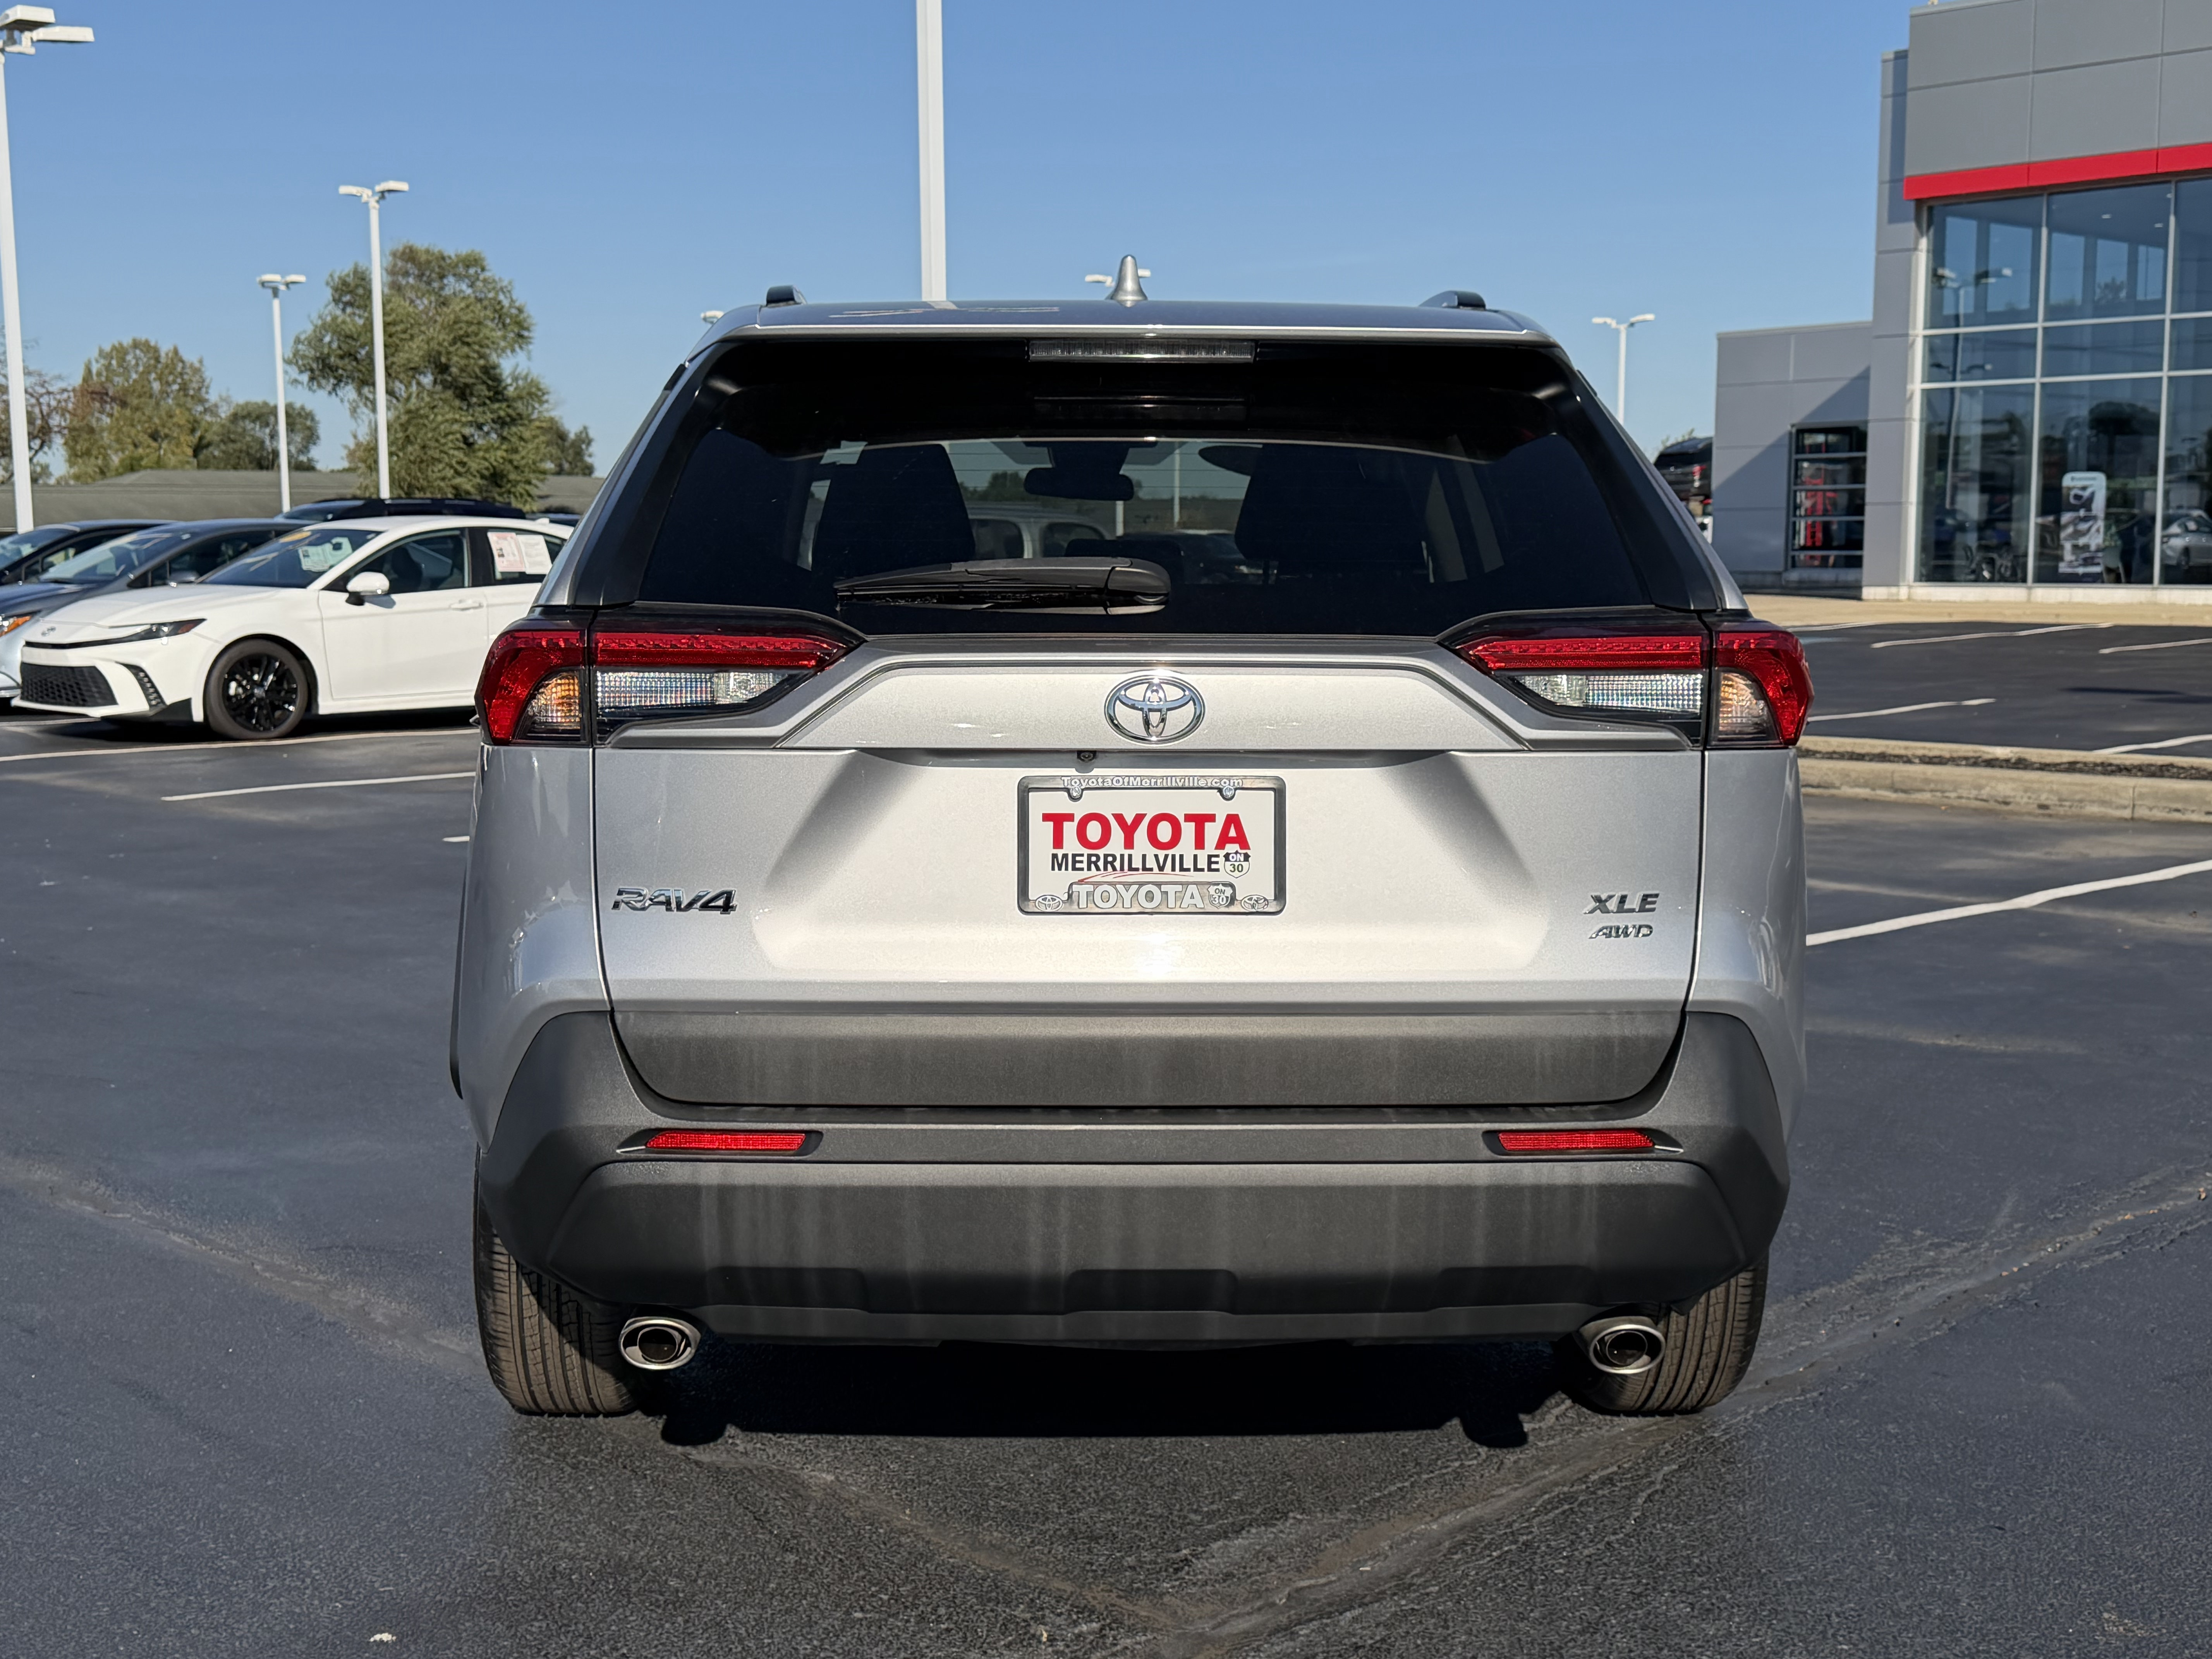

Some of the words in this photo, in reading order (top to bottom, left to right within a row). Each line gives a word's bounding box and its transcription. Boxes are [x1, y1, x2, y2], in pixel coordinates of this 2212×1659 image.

[1061, 776, 1243, 788] ToyotaOfMerrillville.com
[1042, 812, 1251, 850] TOYOTA
[1051, 853, 1220, 872] MERRILLVILLE
[1229, 854, 1244, 862] ON
[1230, 863, 1244, 873] 30
[611, 887, 738, 914] RAV4
[1072, 884, 1205, 909] TOYOTA
[1212, 895, 1226, 905] 30
[1583, 891, 1660, 915] XLE
[1588, 924, 1654, 939] AWD
